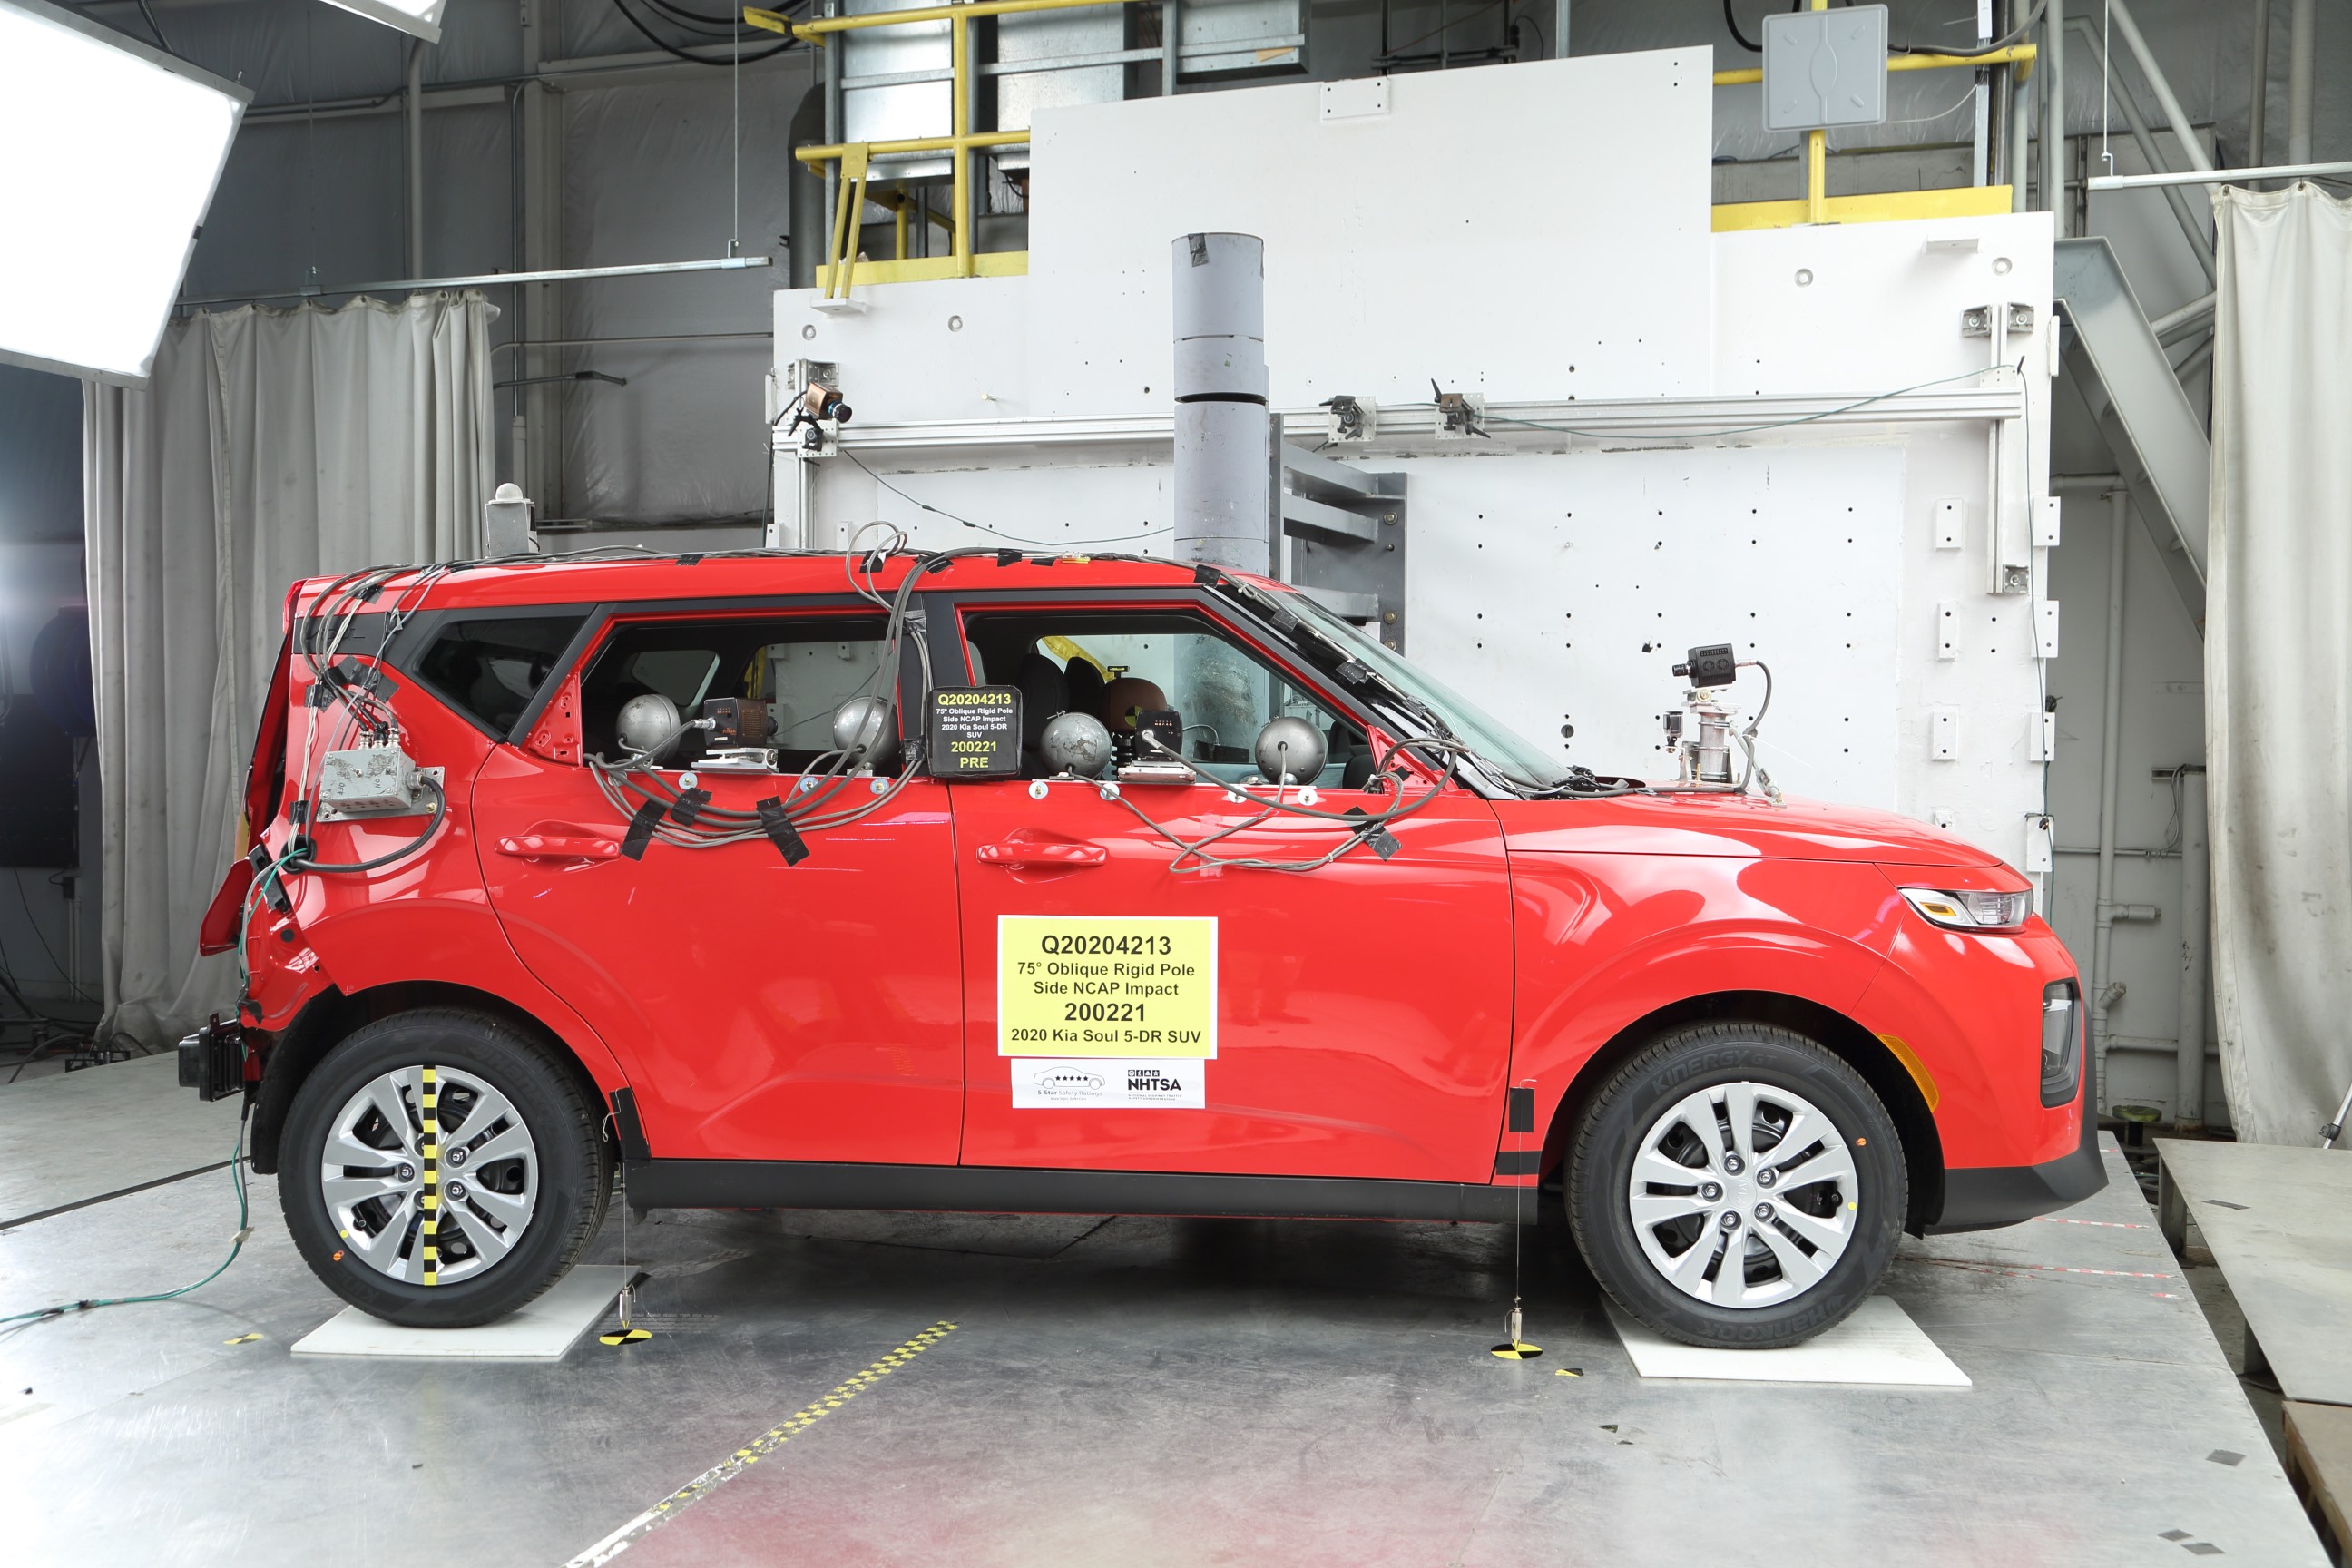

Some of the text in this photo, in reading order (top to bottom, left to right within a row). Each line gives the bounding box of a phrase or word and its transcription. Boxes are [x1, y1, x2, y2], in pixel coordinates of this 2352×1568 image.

[937, 693, 1012, 706] Q20204213
[948, 708, 976, 716] Oblique
[977, 707, 996, 716] Rigid
[943, 715, 959, 723] Side
[982, 715, 1006, 724] Impact
[950, 740, 996, 753] 200221
[960, 756, 989, 769] PRE
[1041, 935, 1171, 956] Q20204213
[1047, 962, 1109, 979] Oblique
[1114, 963, 1155, 979] Rigid
[1161, 963, 1195, 976] Pole
[1034, 981, 1179, 998] Side NCAP Impact
[1064, 1002, 1144, 1022] 200221
[1011, 1028, 1201, 1044] 2020 Kia Soul 5-DR SUV
[1127, 1078, 1182, 1092] NHTSA
[1078, 1089, 1102, 1098] Ratings
